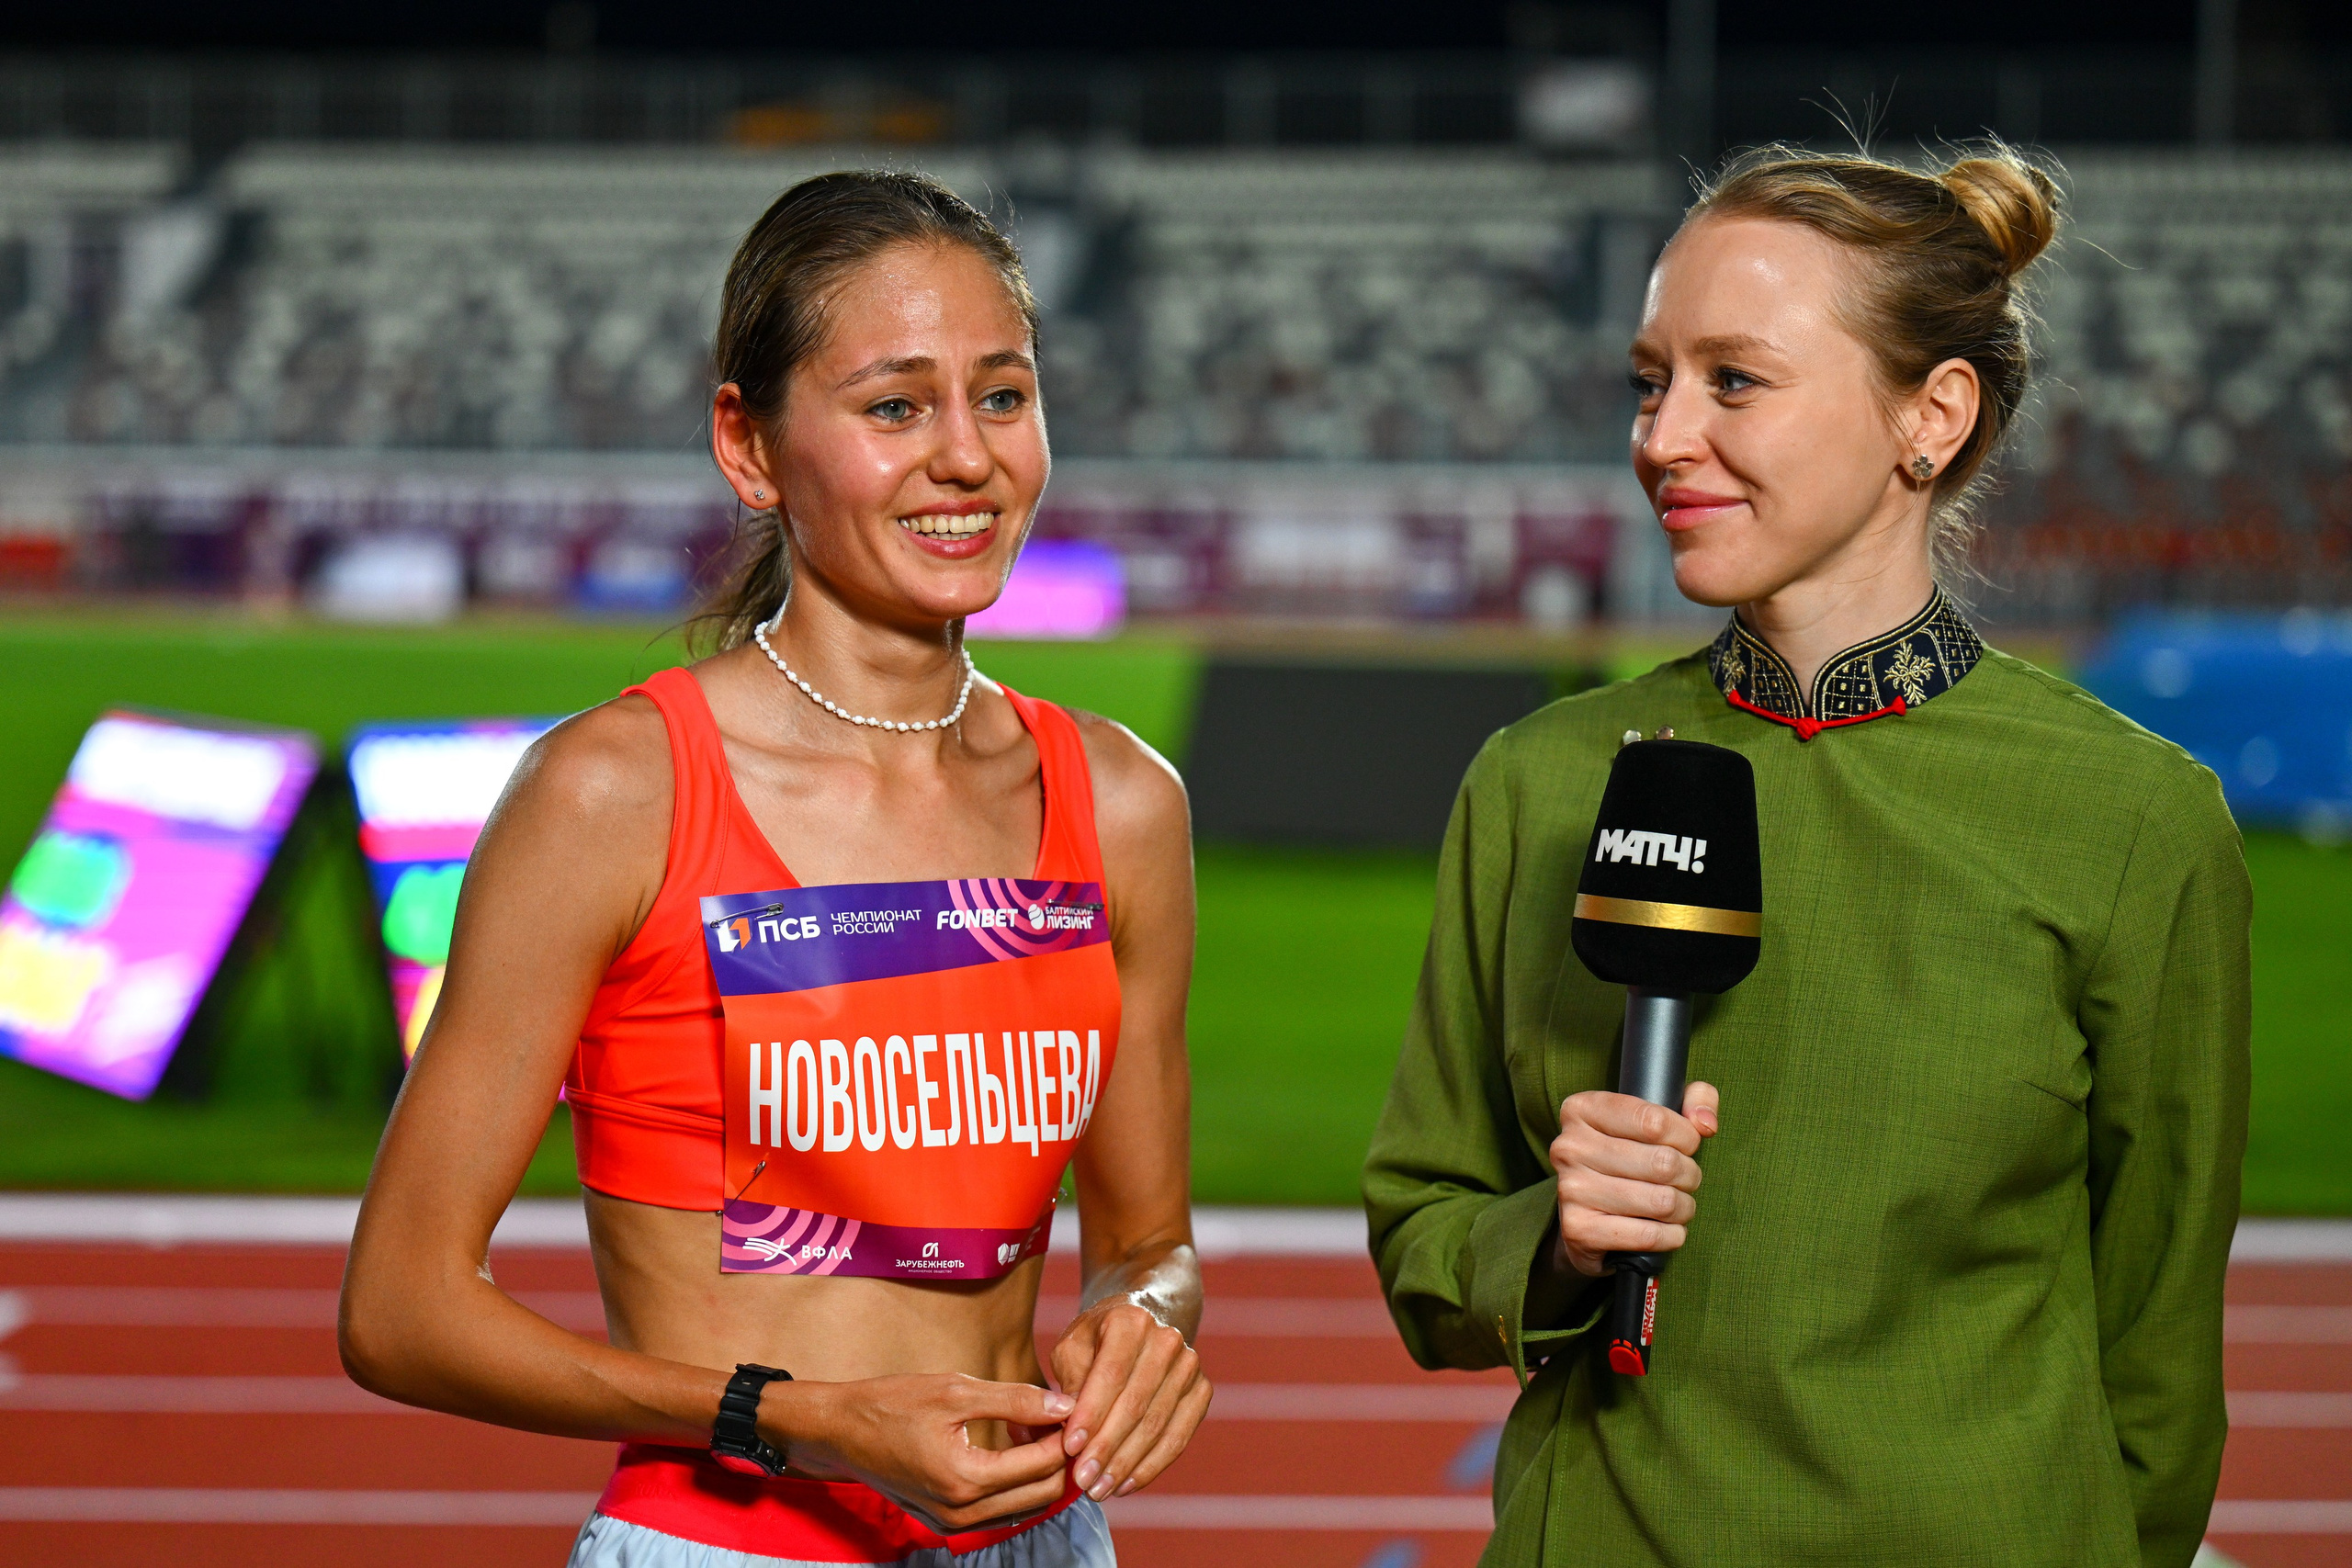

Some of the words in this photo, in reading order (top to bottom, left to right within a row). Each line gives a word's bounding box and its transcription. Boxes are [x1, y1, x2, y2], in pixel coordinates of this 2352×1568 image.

[1595, 829, 1707, 874] МАТЧ!
[831, 909, 922, 924] ЧЕМПИОНАТ
[936, 908, 1018, 930] FONBET
[1046, 916, 1094, 930] ЛИЗИНГ
[758, 916, 820, 943] ПСБ
[832, 921, 894, 935] РОССИИ
[749, 1030, 1100, 1157] НОВОСЕЛЬЦЕВА
[801, 1245, 853, 1260] ВФЛА
[895, 1259, 965, 1269] ЗАРУБЕЖНЕФТЬ
